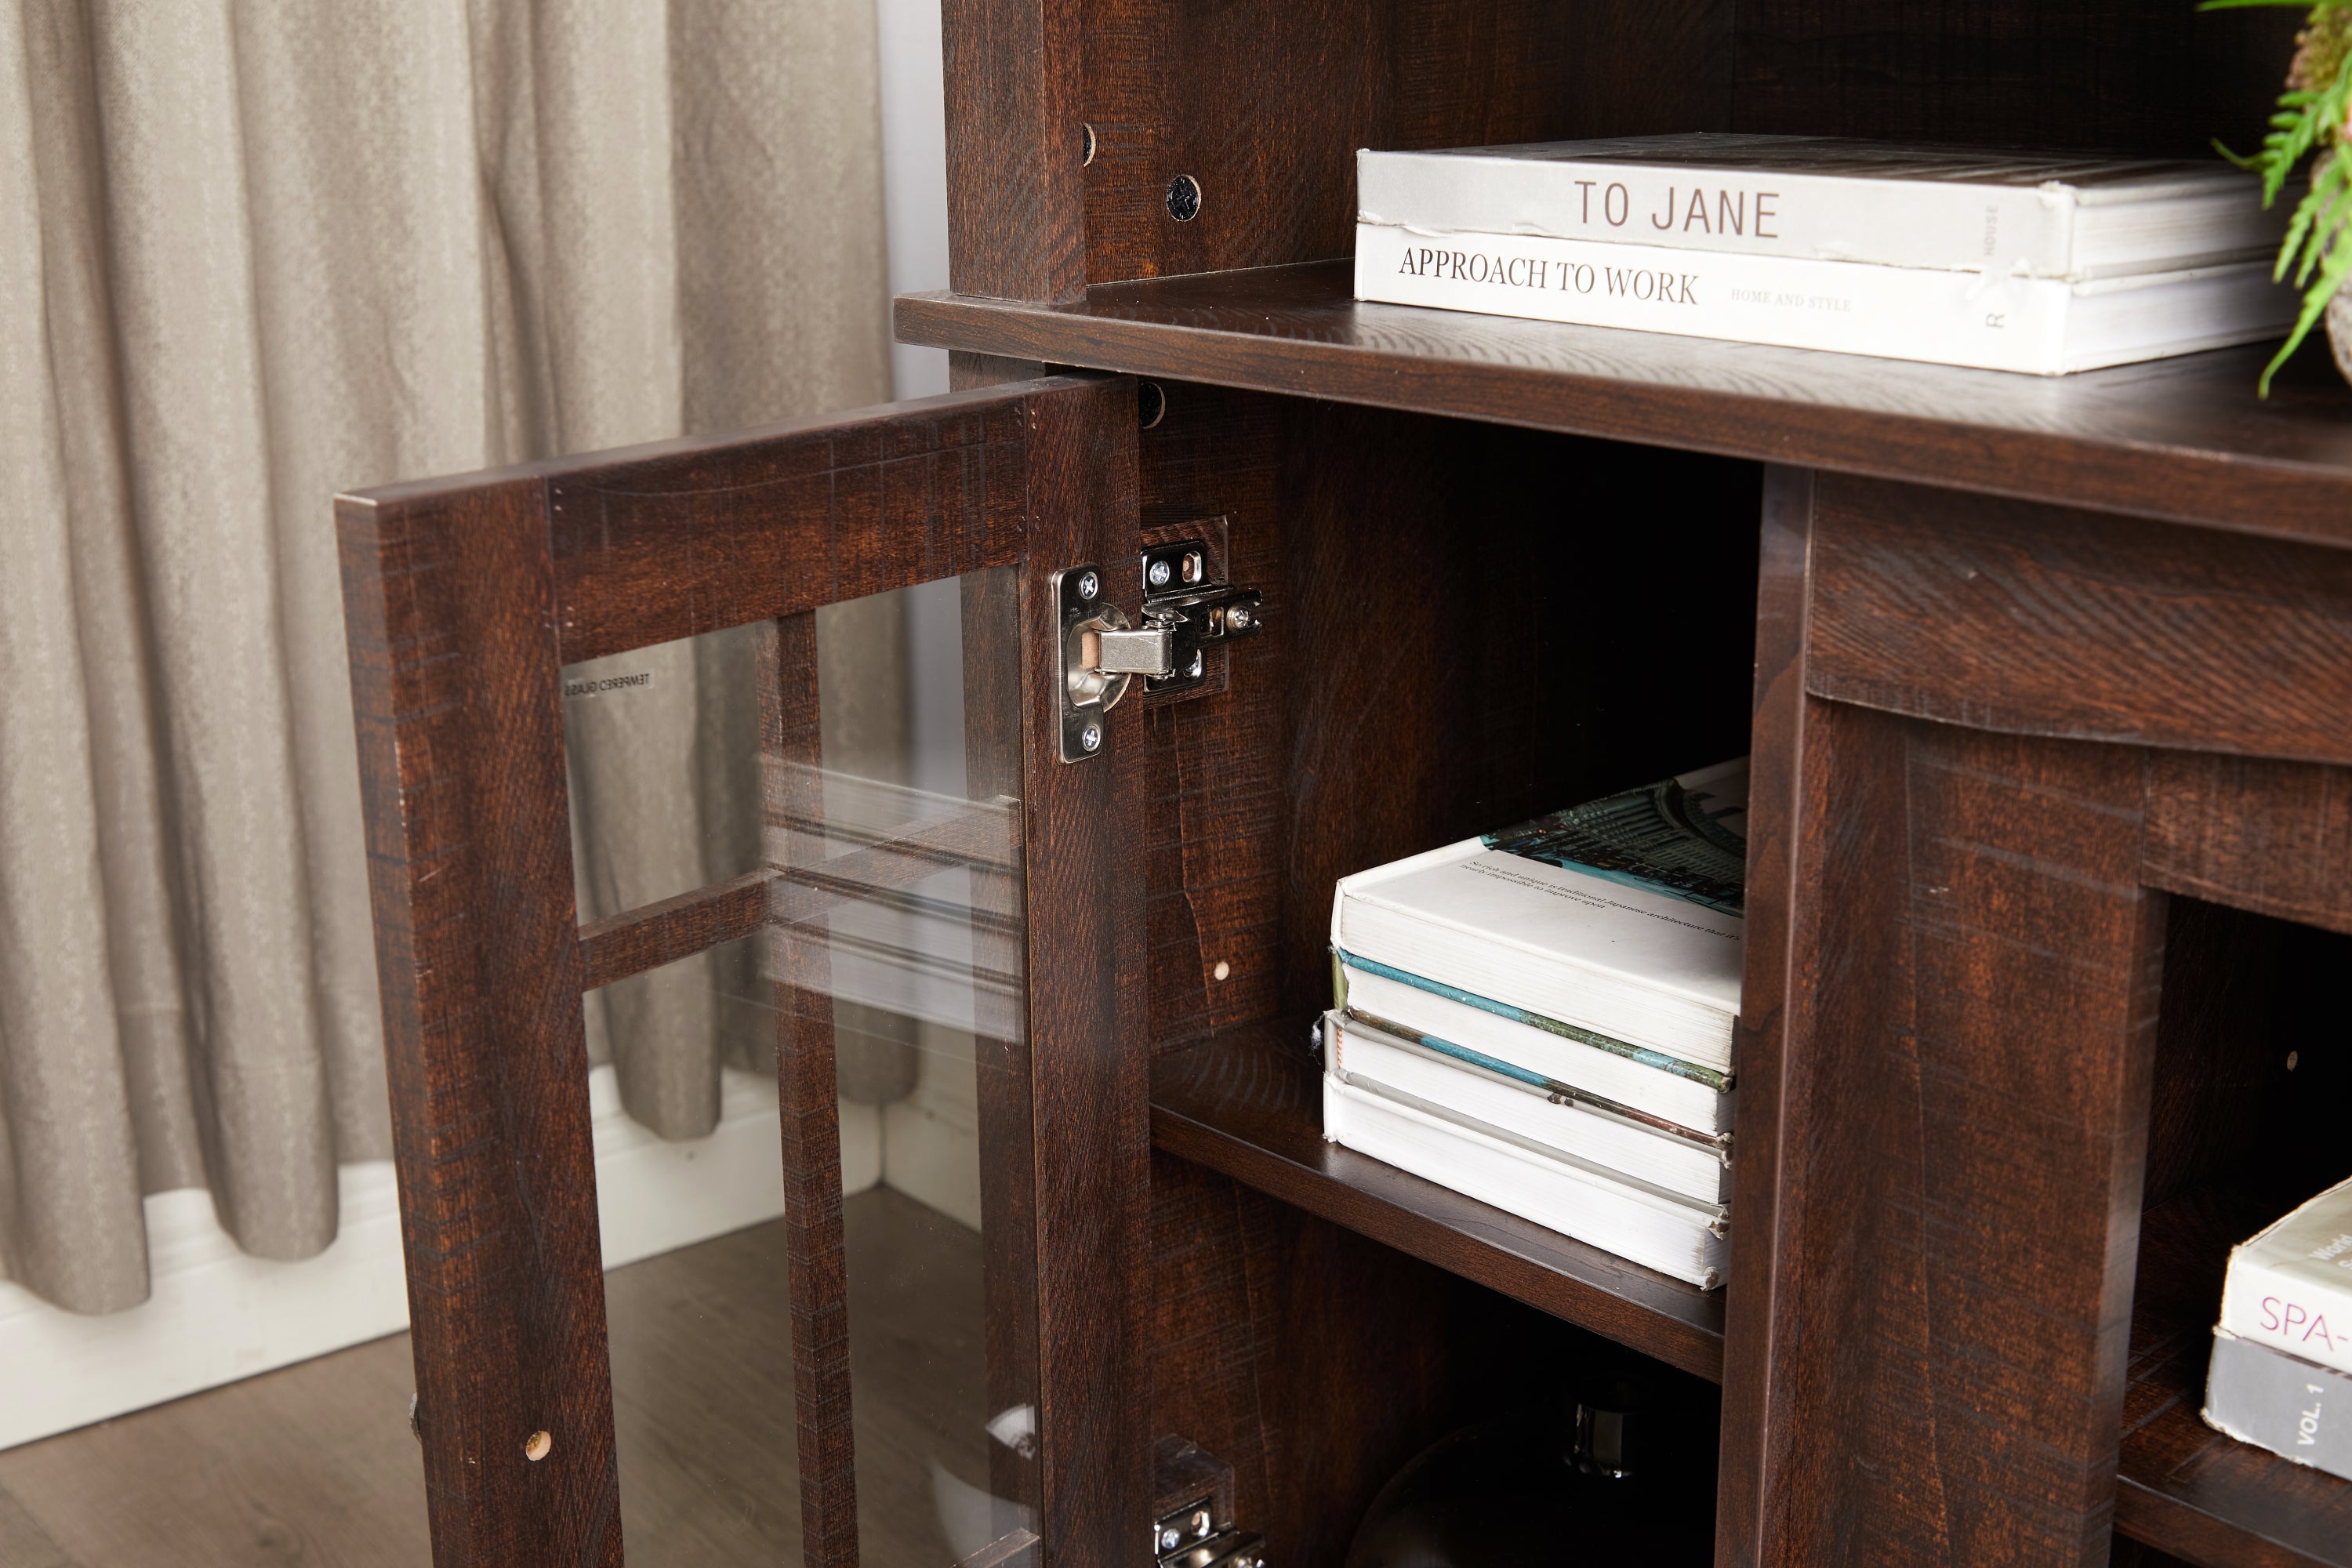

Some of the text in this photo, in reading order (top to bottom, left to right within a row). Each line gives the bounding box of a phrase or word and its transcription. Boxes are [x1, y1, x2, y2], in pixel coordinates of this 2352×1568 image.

[1574, 180, 1780, 238] TO JANE
[1984, 205, 1999, 256] HOUSE
[1398, 246, 1700, 306] APPROACH TO WORK
[1730, 288, 1851, 312] HOME AND STYLE
[1460, 864, 1486, 874] nearly
[1487, 872, 1534, 887] impossible
[1544, 888, 1581, 901] improve
[1581, 899, 1606, 909] upon
[1483, 863, 1500, 872] rich
[1518, 874, 1548, 887] unique
[1557, 886, 1607, 902] traditional
[1604, 900, 1647, 915] Japanese
[1647, 912, 1704, 931] architecture
[1704, 928, 1726, 937] that
[2260, 1296, 2349, 1352] SPA-
[2297, 1383, 2325, 1446] VOL. 1
